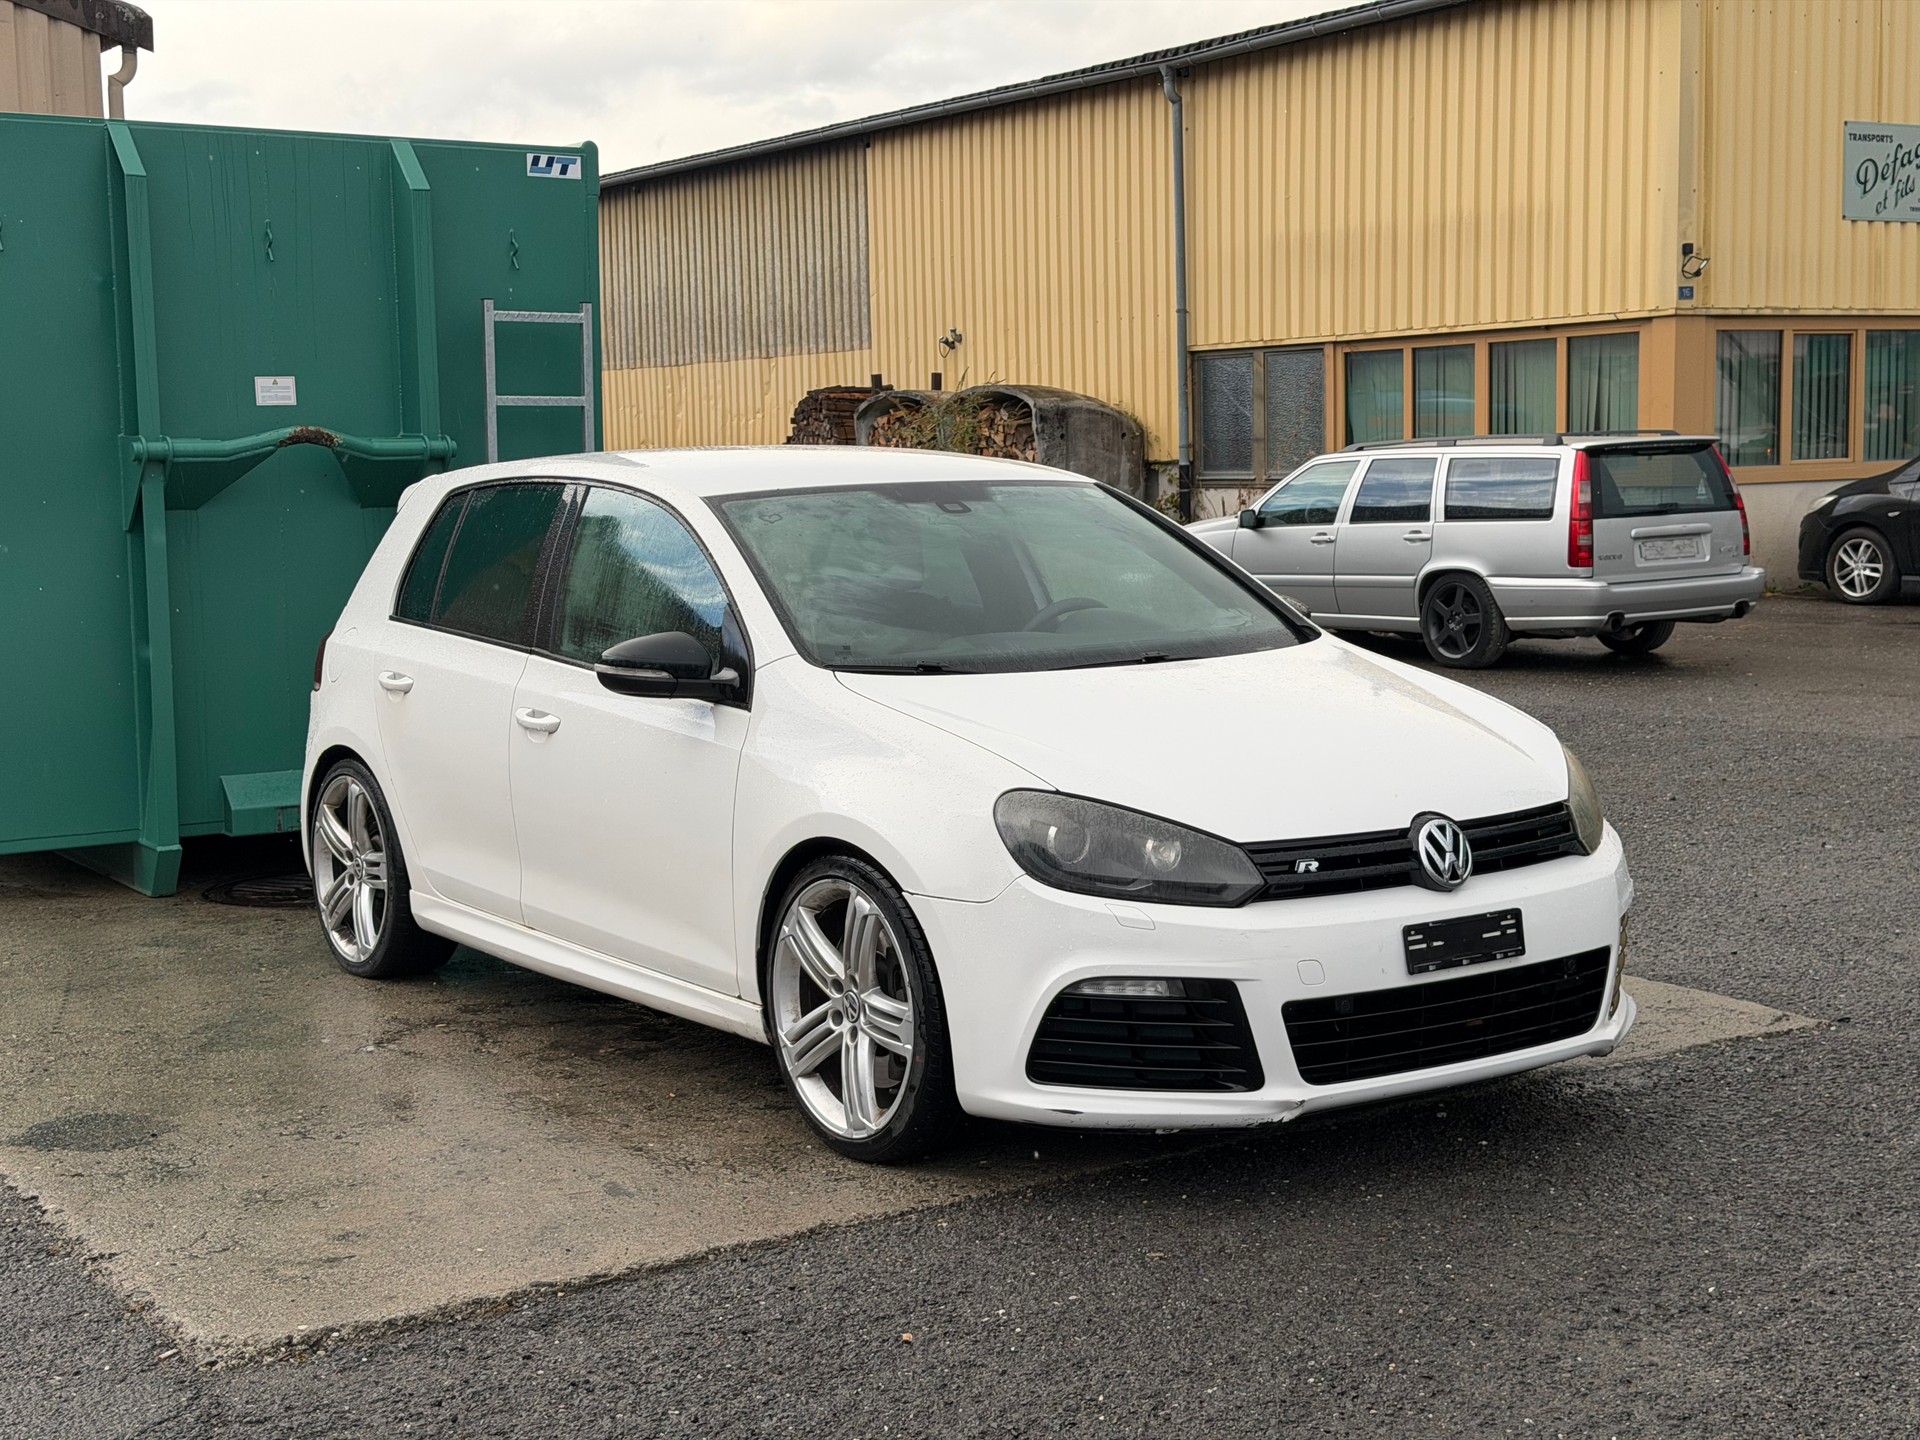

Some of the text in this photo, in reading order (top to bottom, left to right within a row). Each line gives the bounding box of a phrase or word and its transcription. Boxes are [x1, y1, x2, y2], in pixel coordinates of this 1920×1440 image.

[1848, 132, 1894, 143] TRANSPORTS
[529, 155, 578, 176] UT
[1875, 174, 1916, 215] et fils
[1419, 819, 1472, 888] VW
[1295, 858, 1320, 874] R
